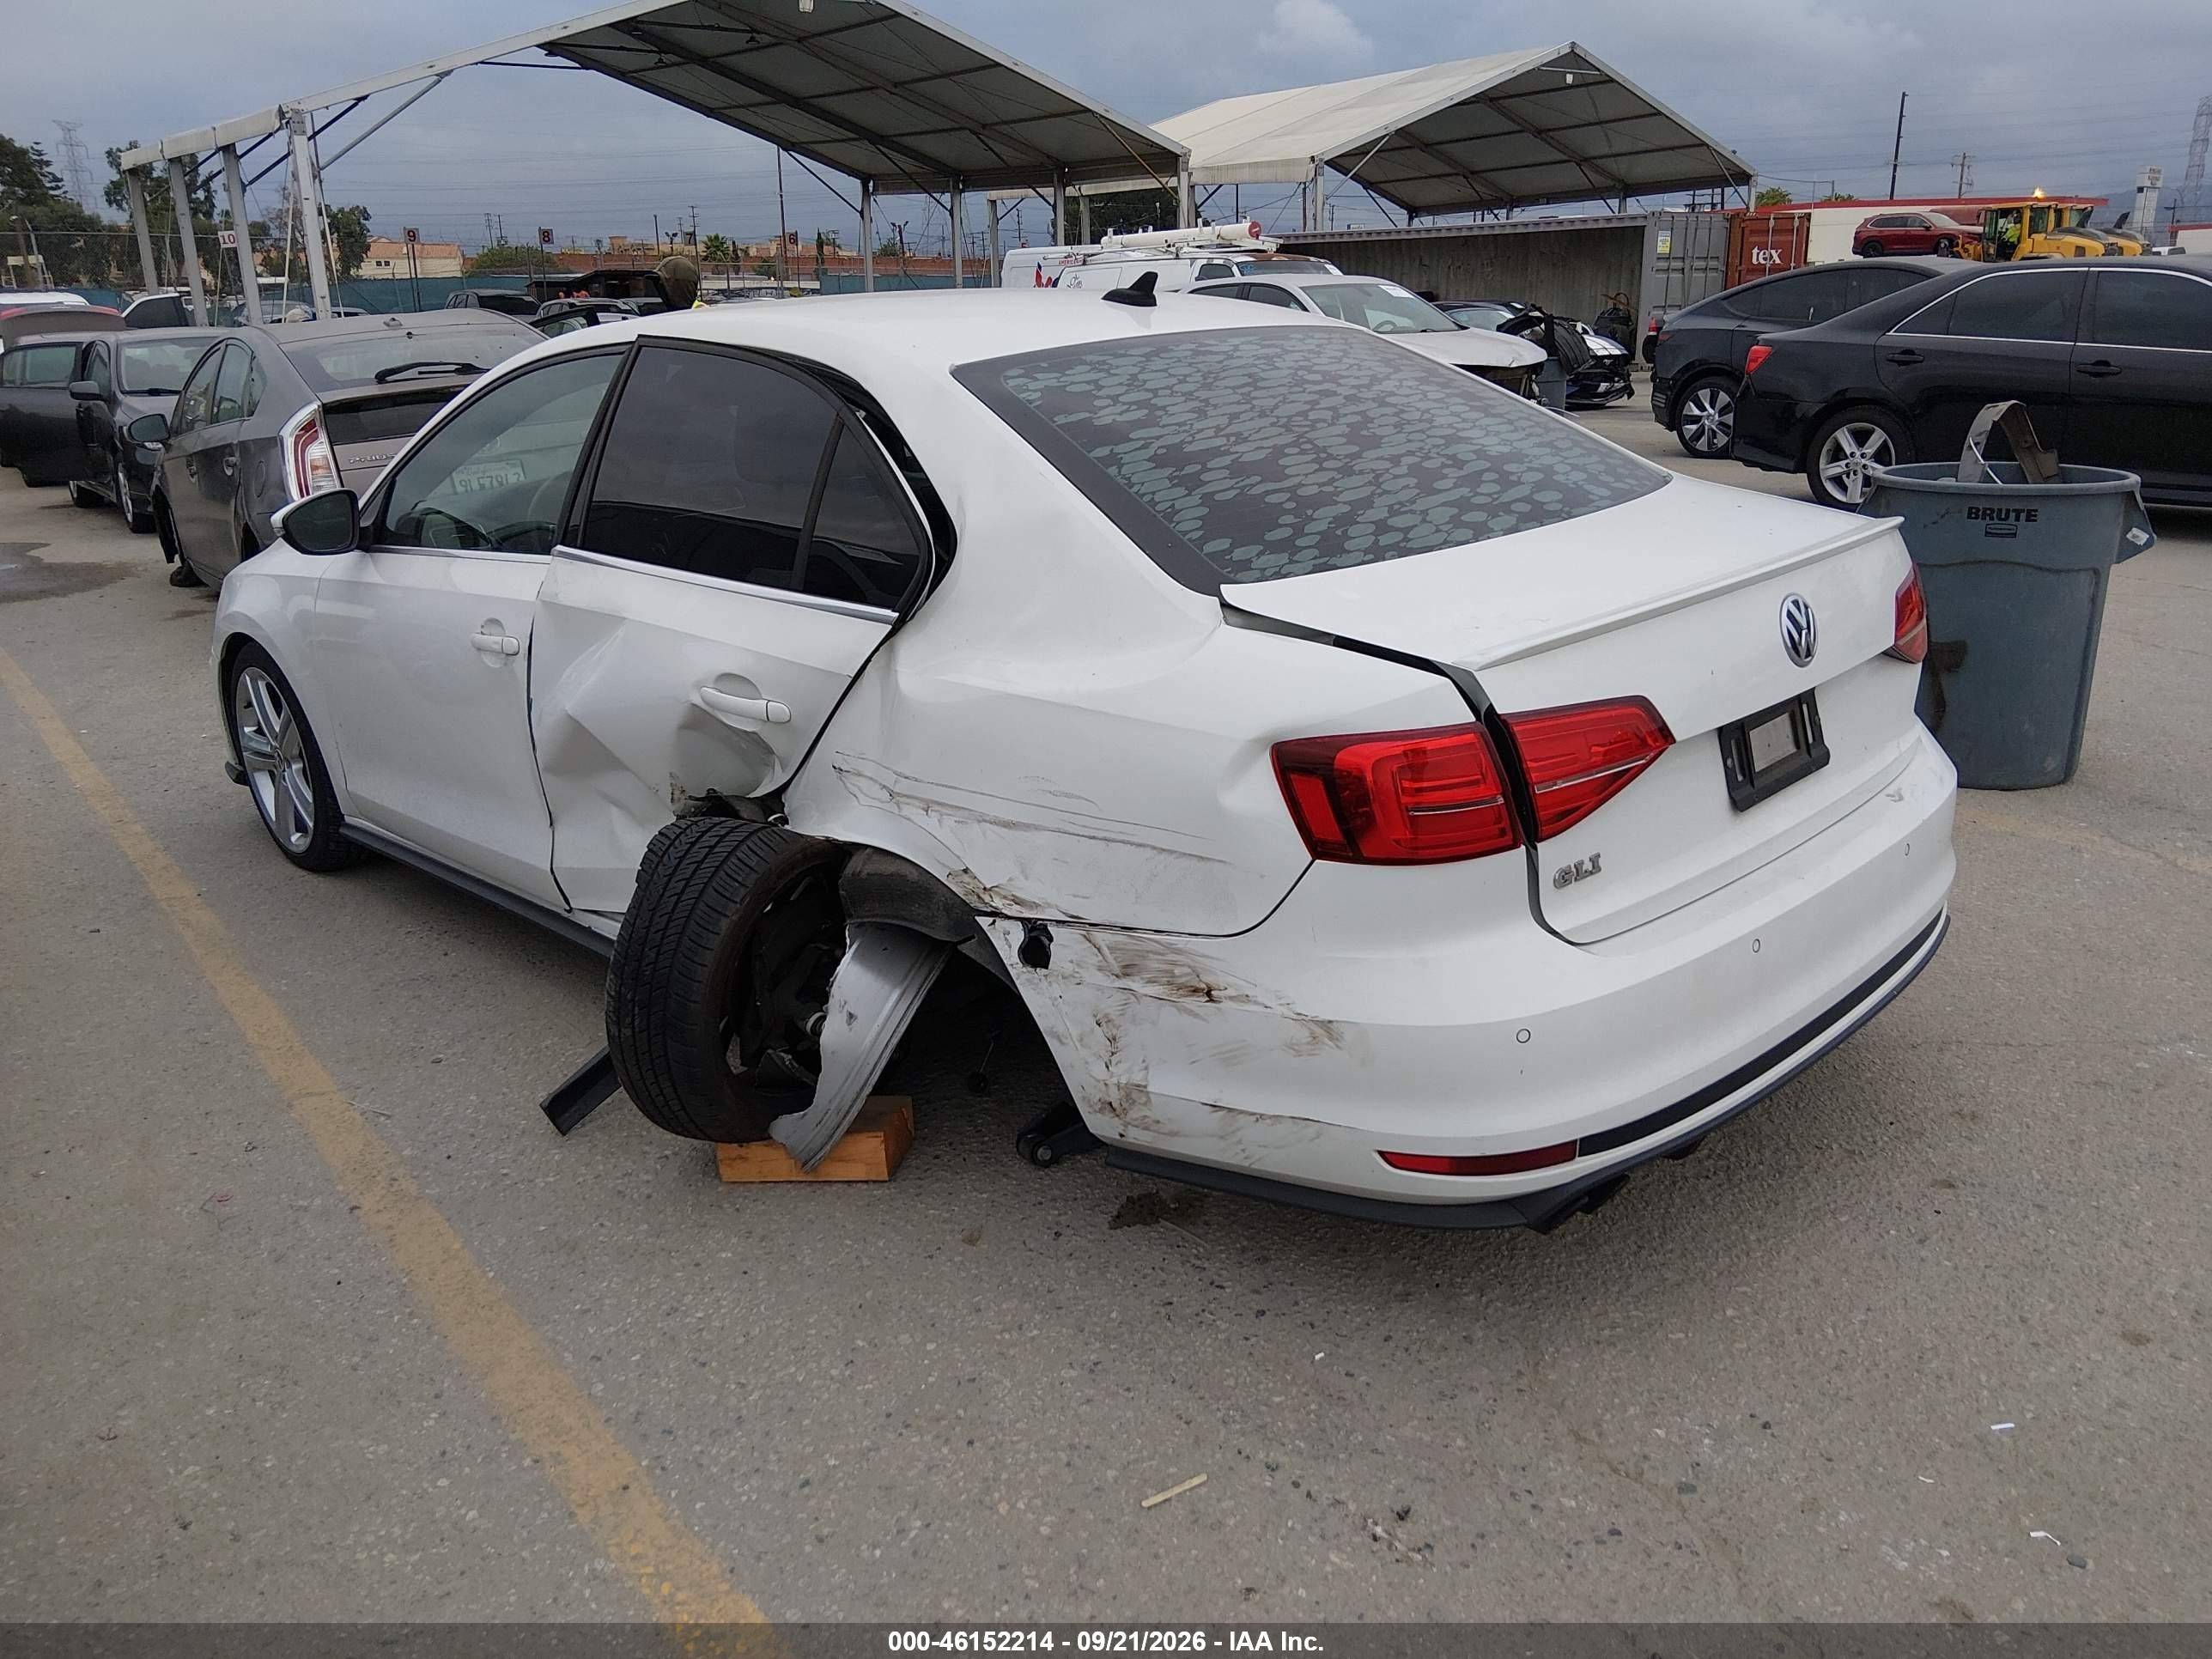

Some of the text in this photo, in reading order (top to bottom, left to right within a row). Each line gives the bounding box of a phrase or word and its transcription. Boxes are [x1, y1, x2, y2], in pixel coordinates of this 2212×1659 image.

[220, 234, 236, 245] 10
[407, 229, 416, 242] 9
[542, 230, 552, 243] 8
[685, 233, 694, 245] 7
[788, 233, 796, 245] 6
[1751, 245, 1784, 264] tex
[348, 453, 397, 464] PRIUS
[1966, 506, 2039, 523] BRUTE
[1553, 852, 1602, 890] GLI
